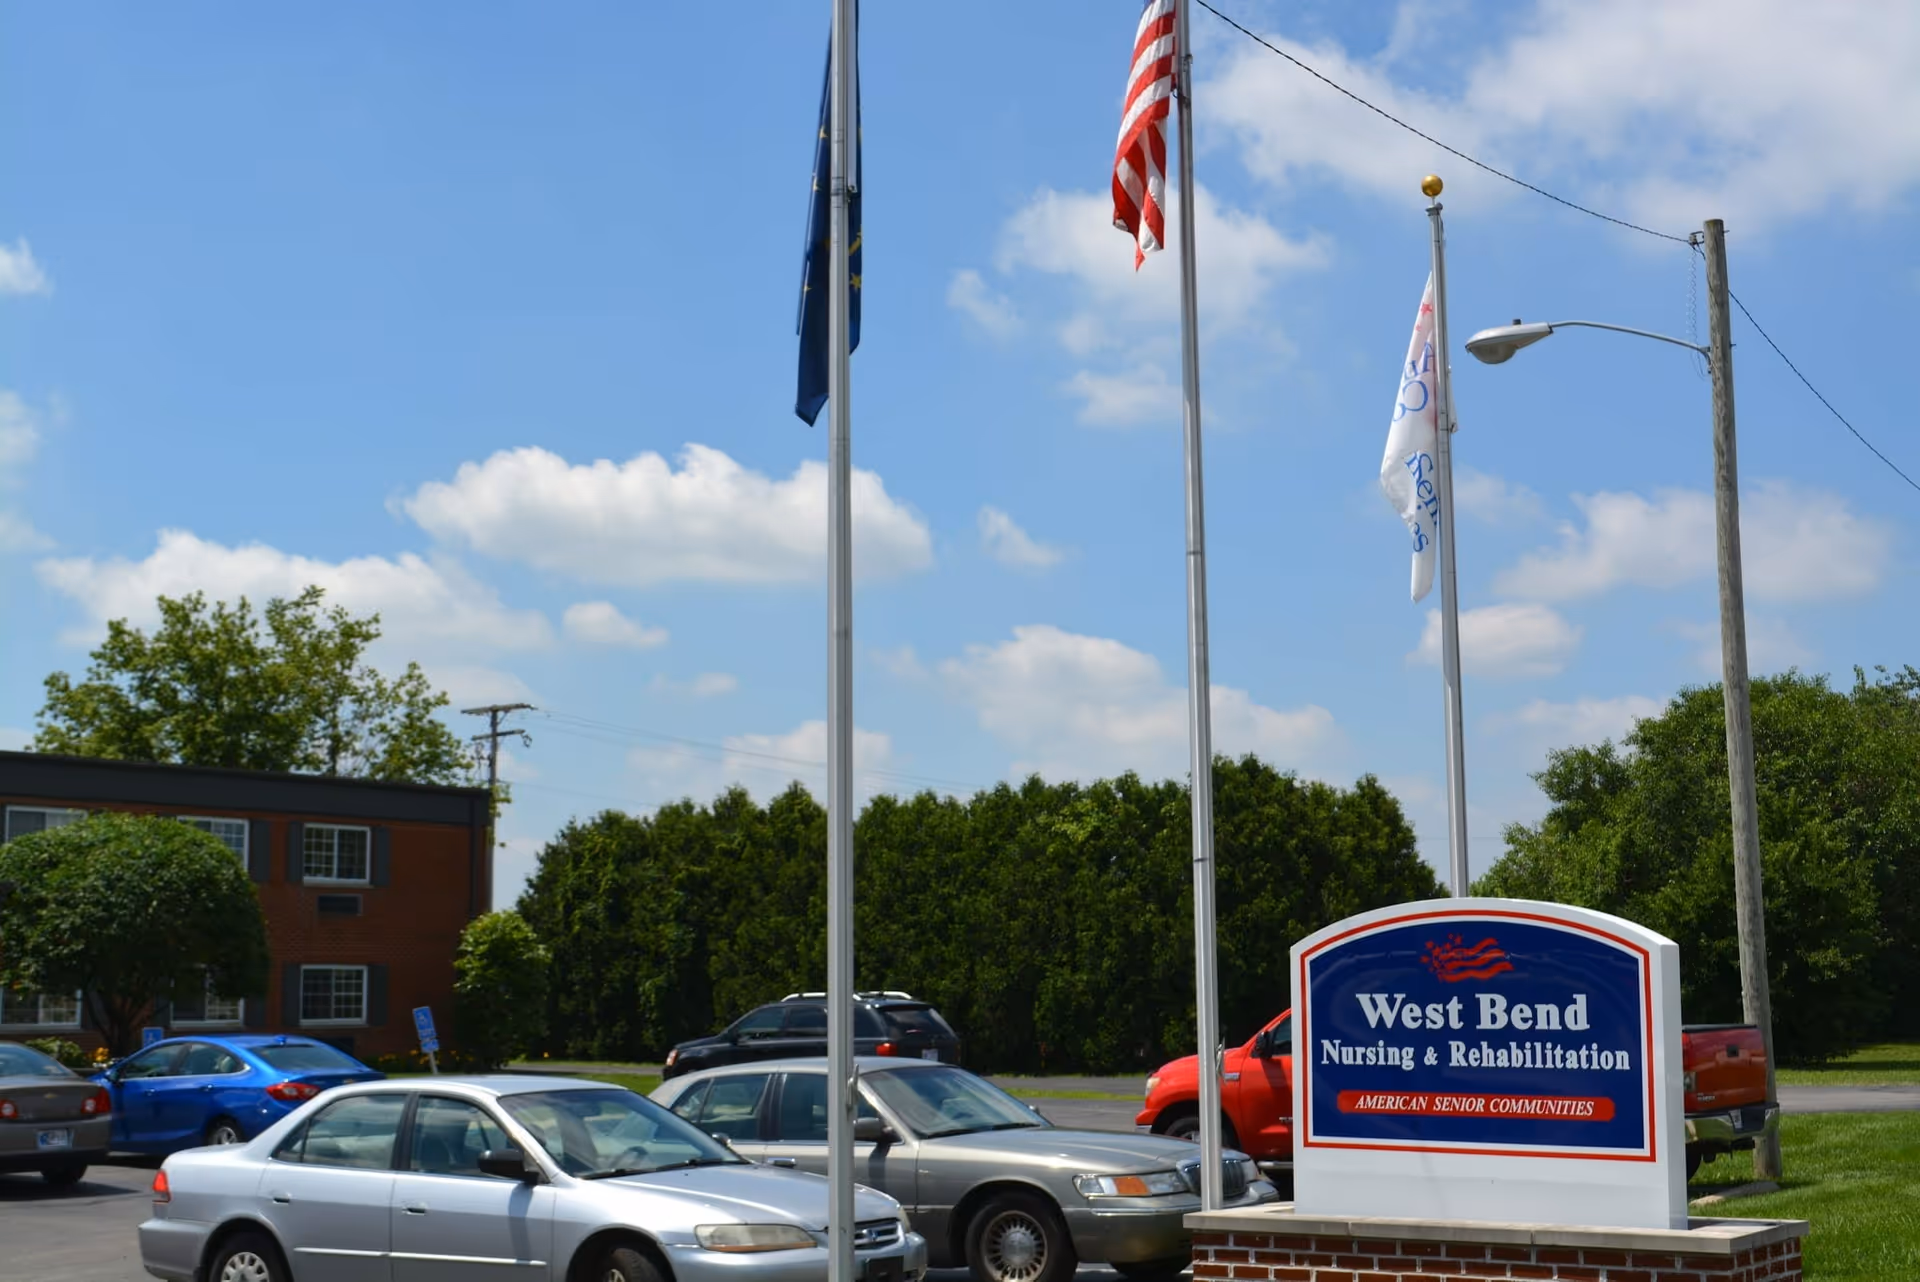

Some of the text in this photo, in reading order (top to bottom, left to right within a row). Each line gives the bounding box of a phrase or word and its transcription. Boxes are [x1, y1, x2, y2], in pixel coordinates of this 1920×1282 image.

[1356, 993, 1590, 1030] West Bend
[1321, 1039, 1631, 1071] Nursing & Rehabilitation
[1355, 1095, 1594, 1116] AMERICAN SENIOR COMMUNITIES
